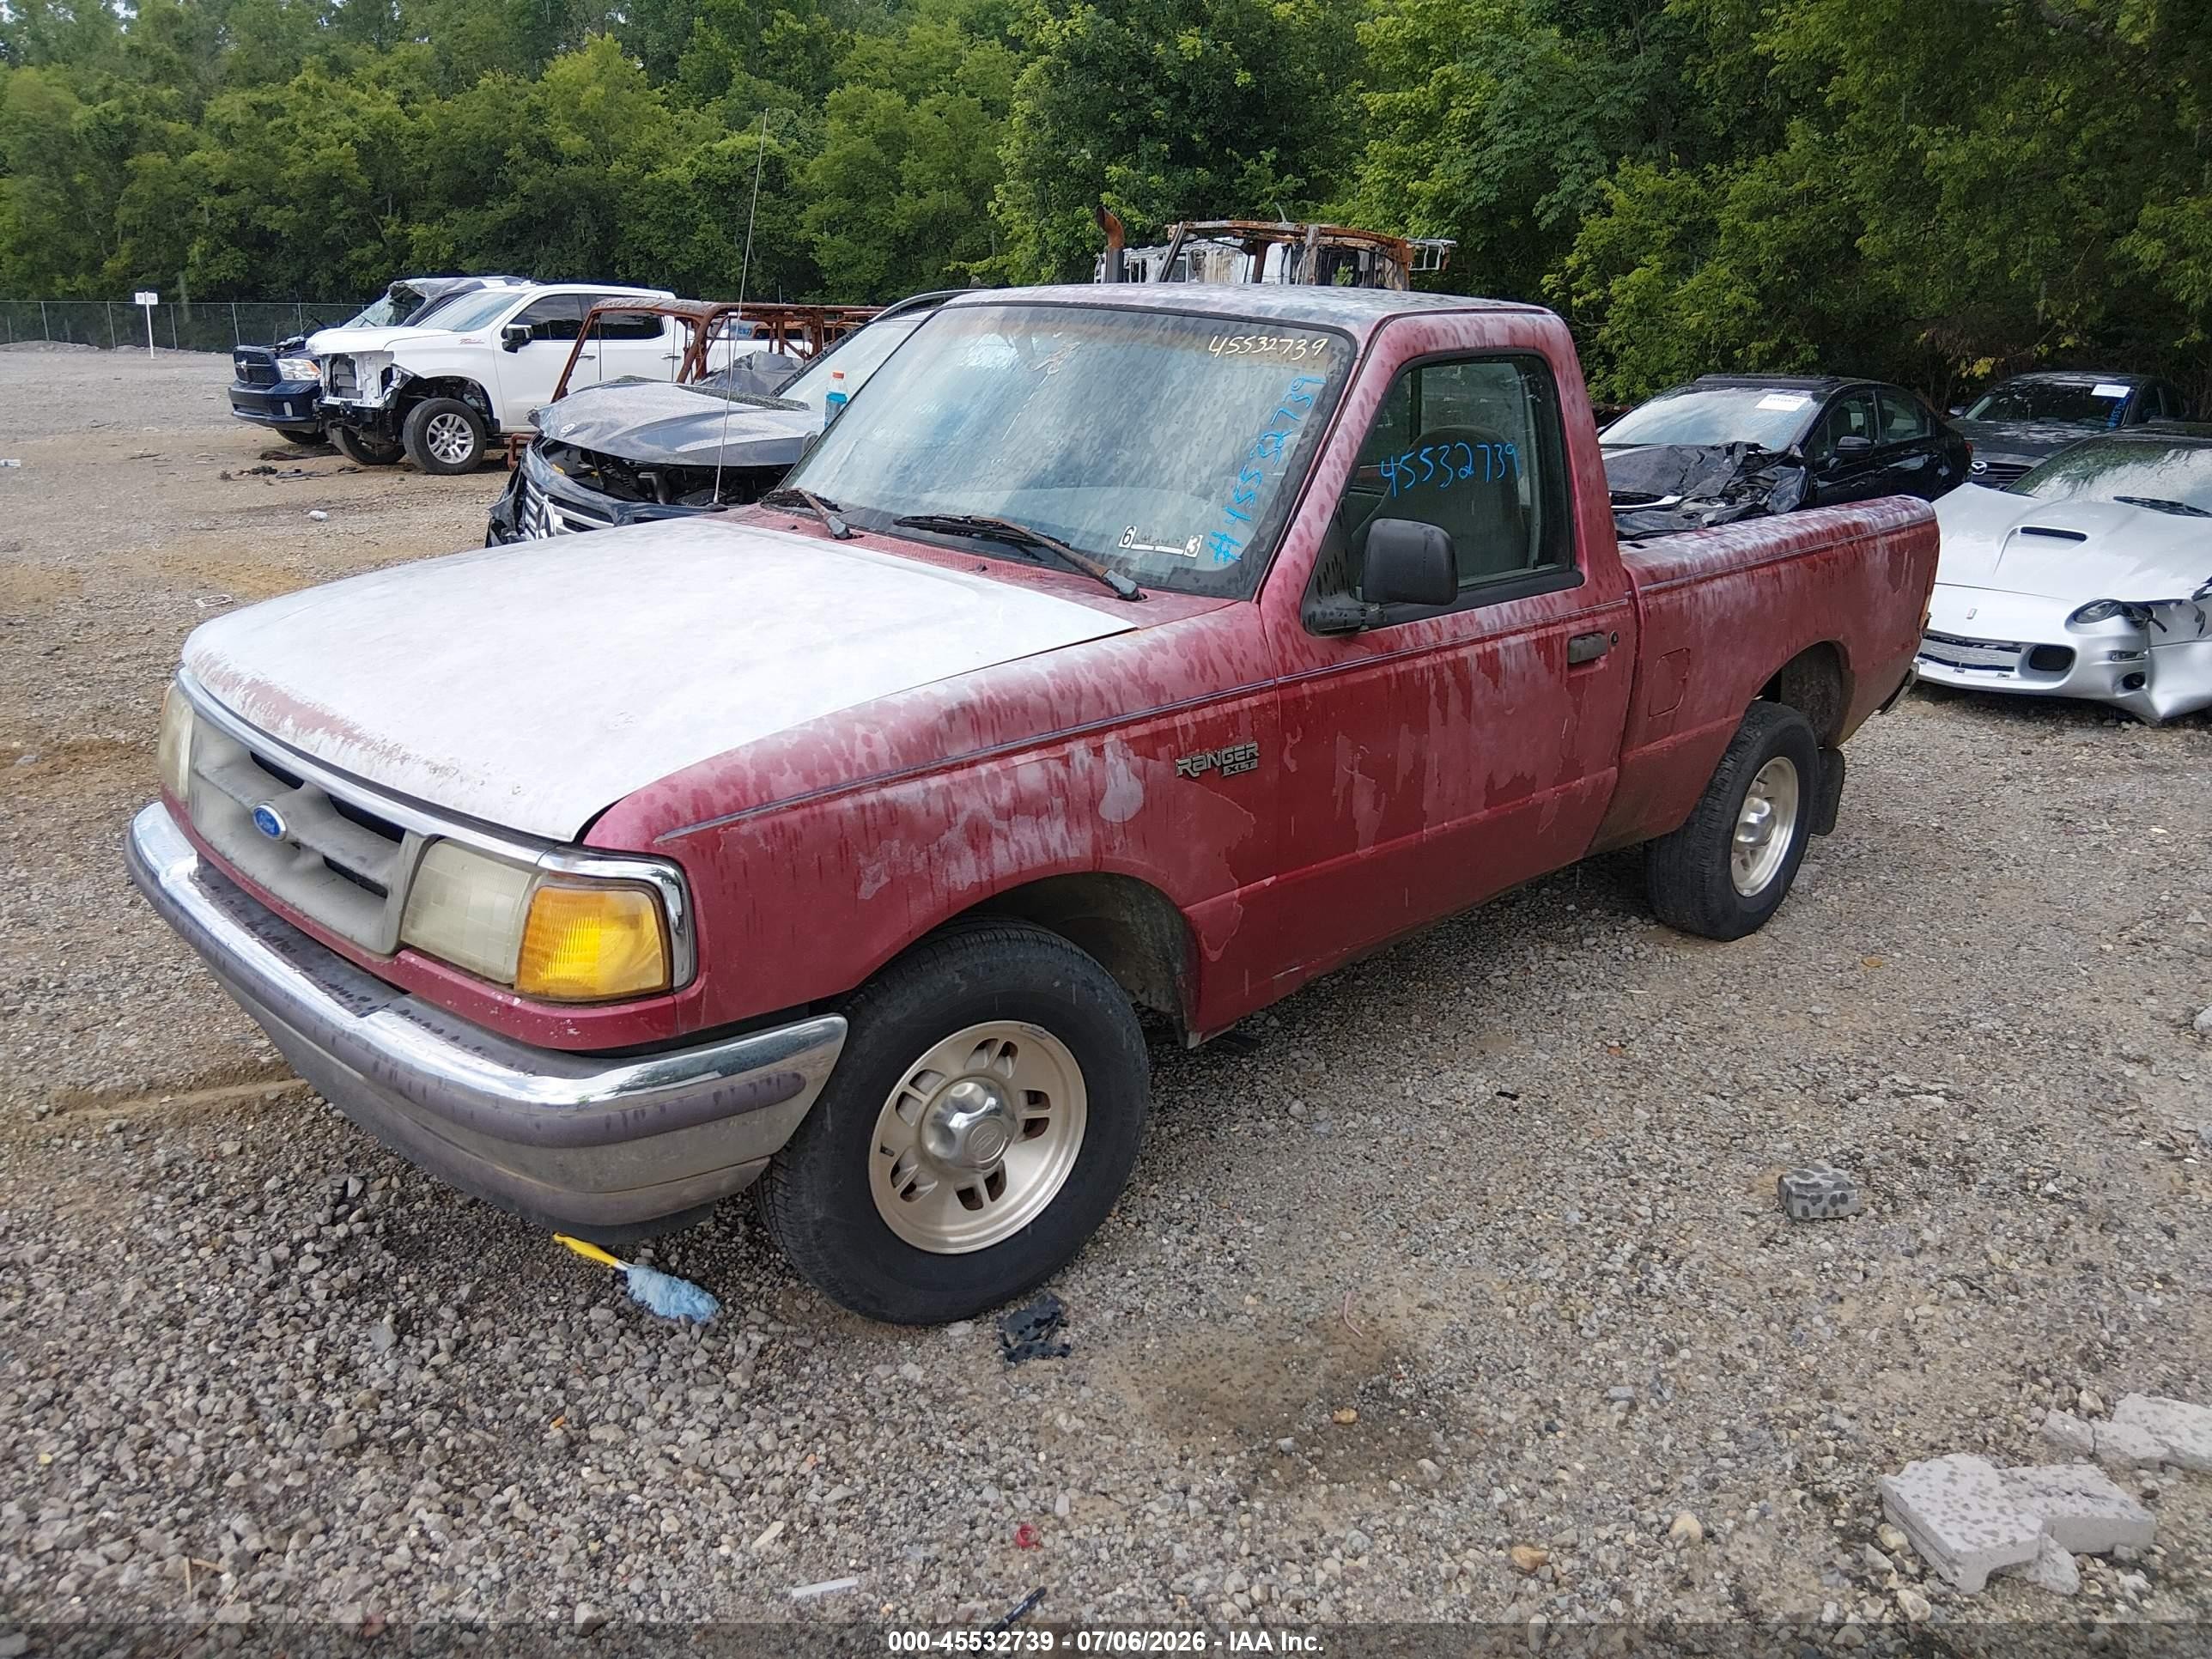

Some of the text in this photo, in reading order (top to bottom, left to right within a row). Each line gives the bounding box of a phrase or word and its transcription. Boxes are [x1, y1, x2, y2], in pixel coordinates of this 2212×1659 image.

[1207, 335, 1328, 361] 45532739
[1379, 441, 1520, 498] 45532739
[1121, 526, 1135, 545] 6
[1186, 536, 1200, 555] 3
[1175, 740, 1261, 777] RANGER
[1227, 760, 1255, 774] XLT
